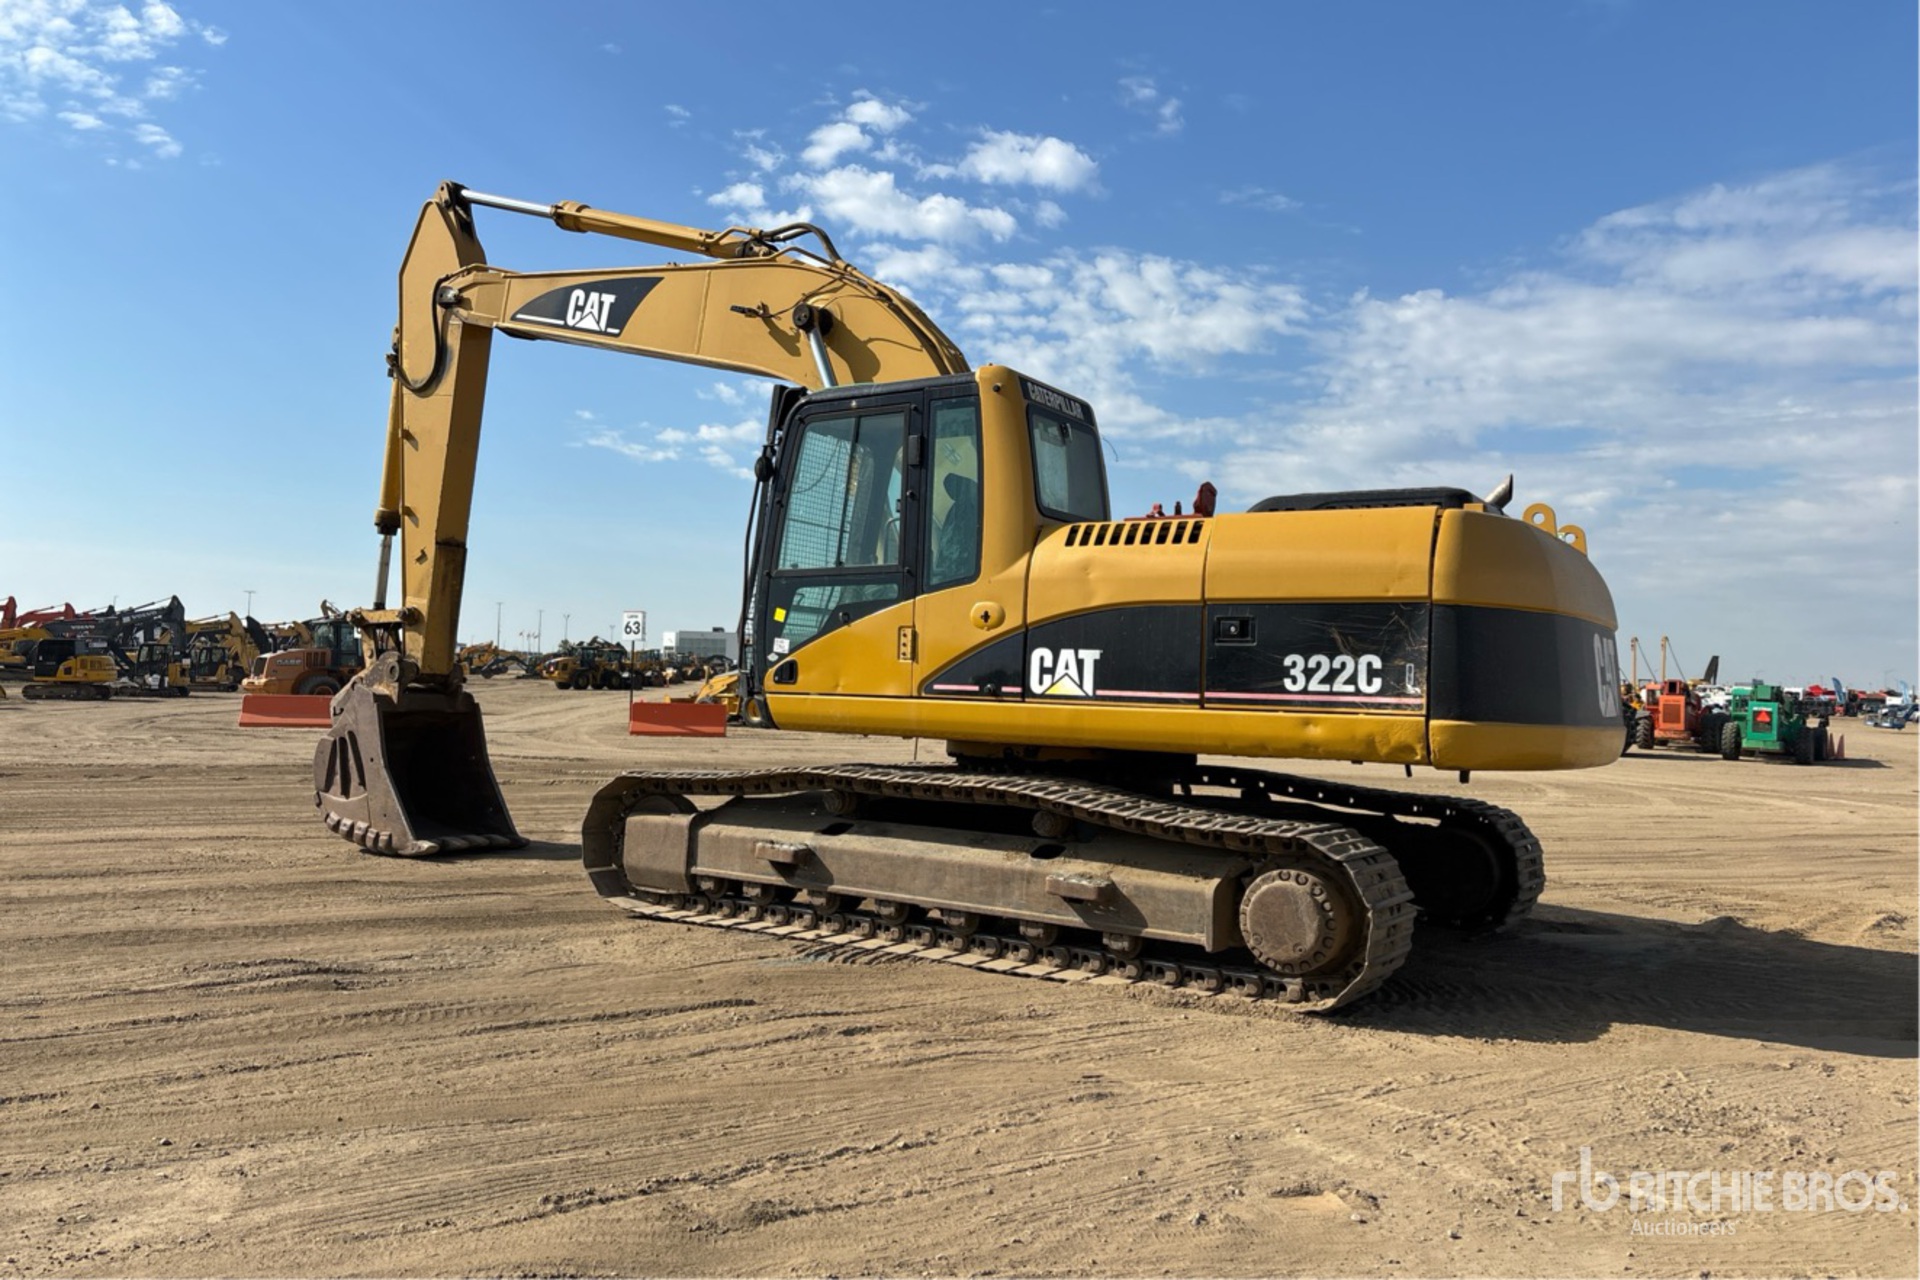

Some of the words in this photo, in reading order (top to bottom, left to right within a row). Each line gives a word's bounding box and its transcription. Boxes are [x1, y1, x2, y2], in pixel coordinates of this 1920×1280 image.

[566, 288, 616, 332] CAT
[1027, 381, 1085, 420] CATERPILLAR
[624, 620, 641, 635] 63
[1029, 647, 1103, 697] CAT
[1283, 654, 1383, 694] 322C
[1593, 632, 1619, 718] CAT
